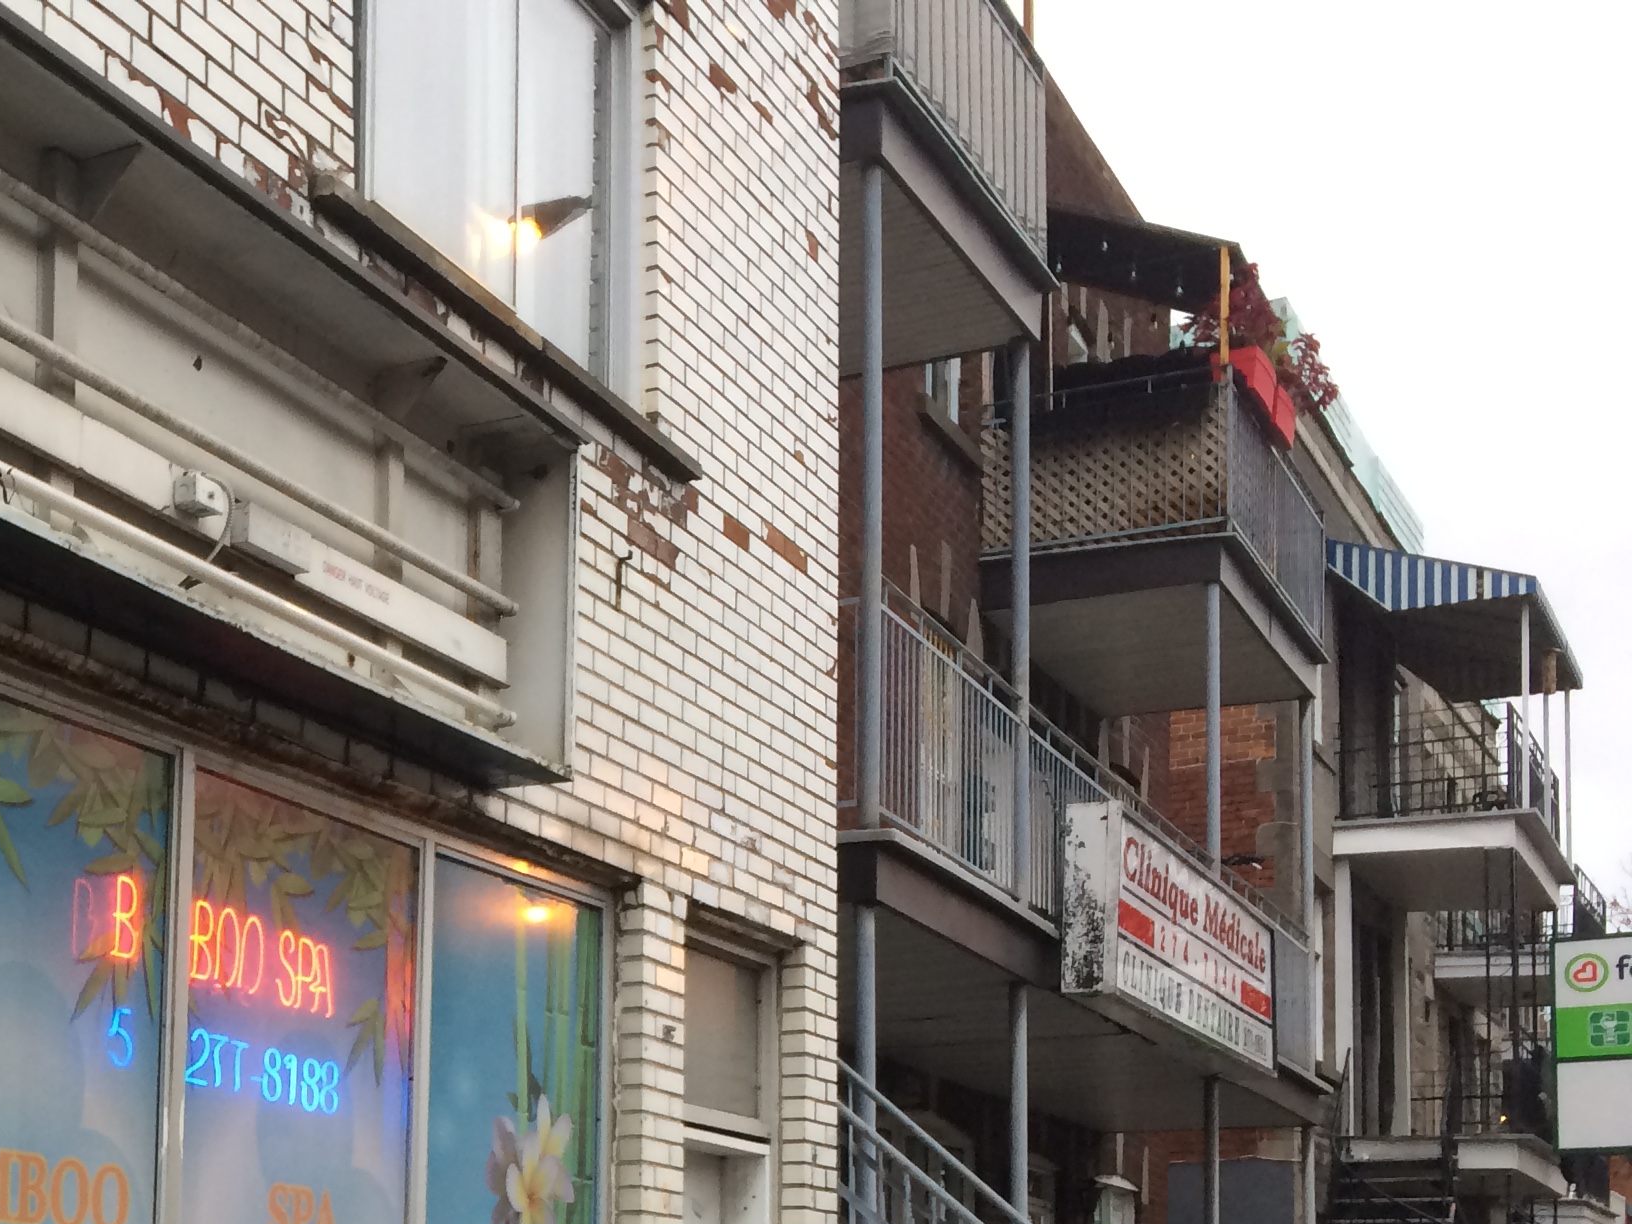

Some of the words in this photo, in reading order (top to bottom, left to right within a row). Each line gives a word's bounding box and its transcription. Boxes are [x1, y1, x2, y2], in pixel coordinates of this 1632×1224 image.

[1123, 837, 1199, 926] Clinique
[1203, 894, 1267, 973] Médicale
[274, 929, 334, 1019] SPA
[1122, 950, 1183, 1015] CLINIQUE
